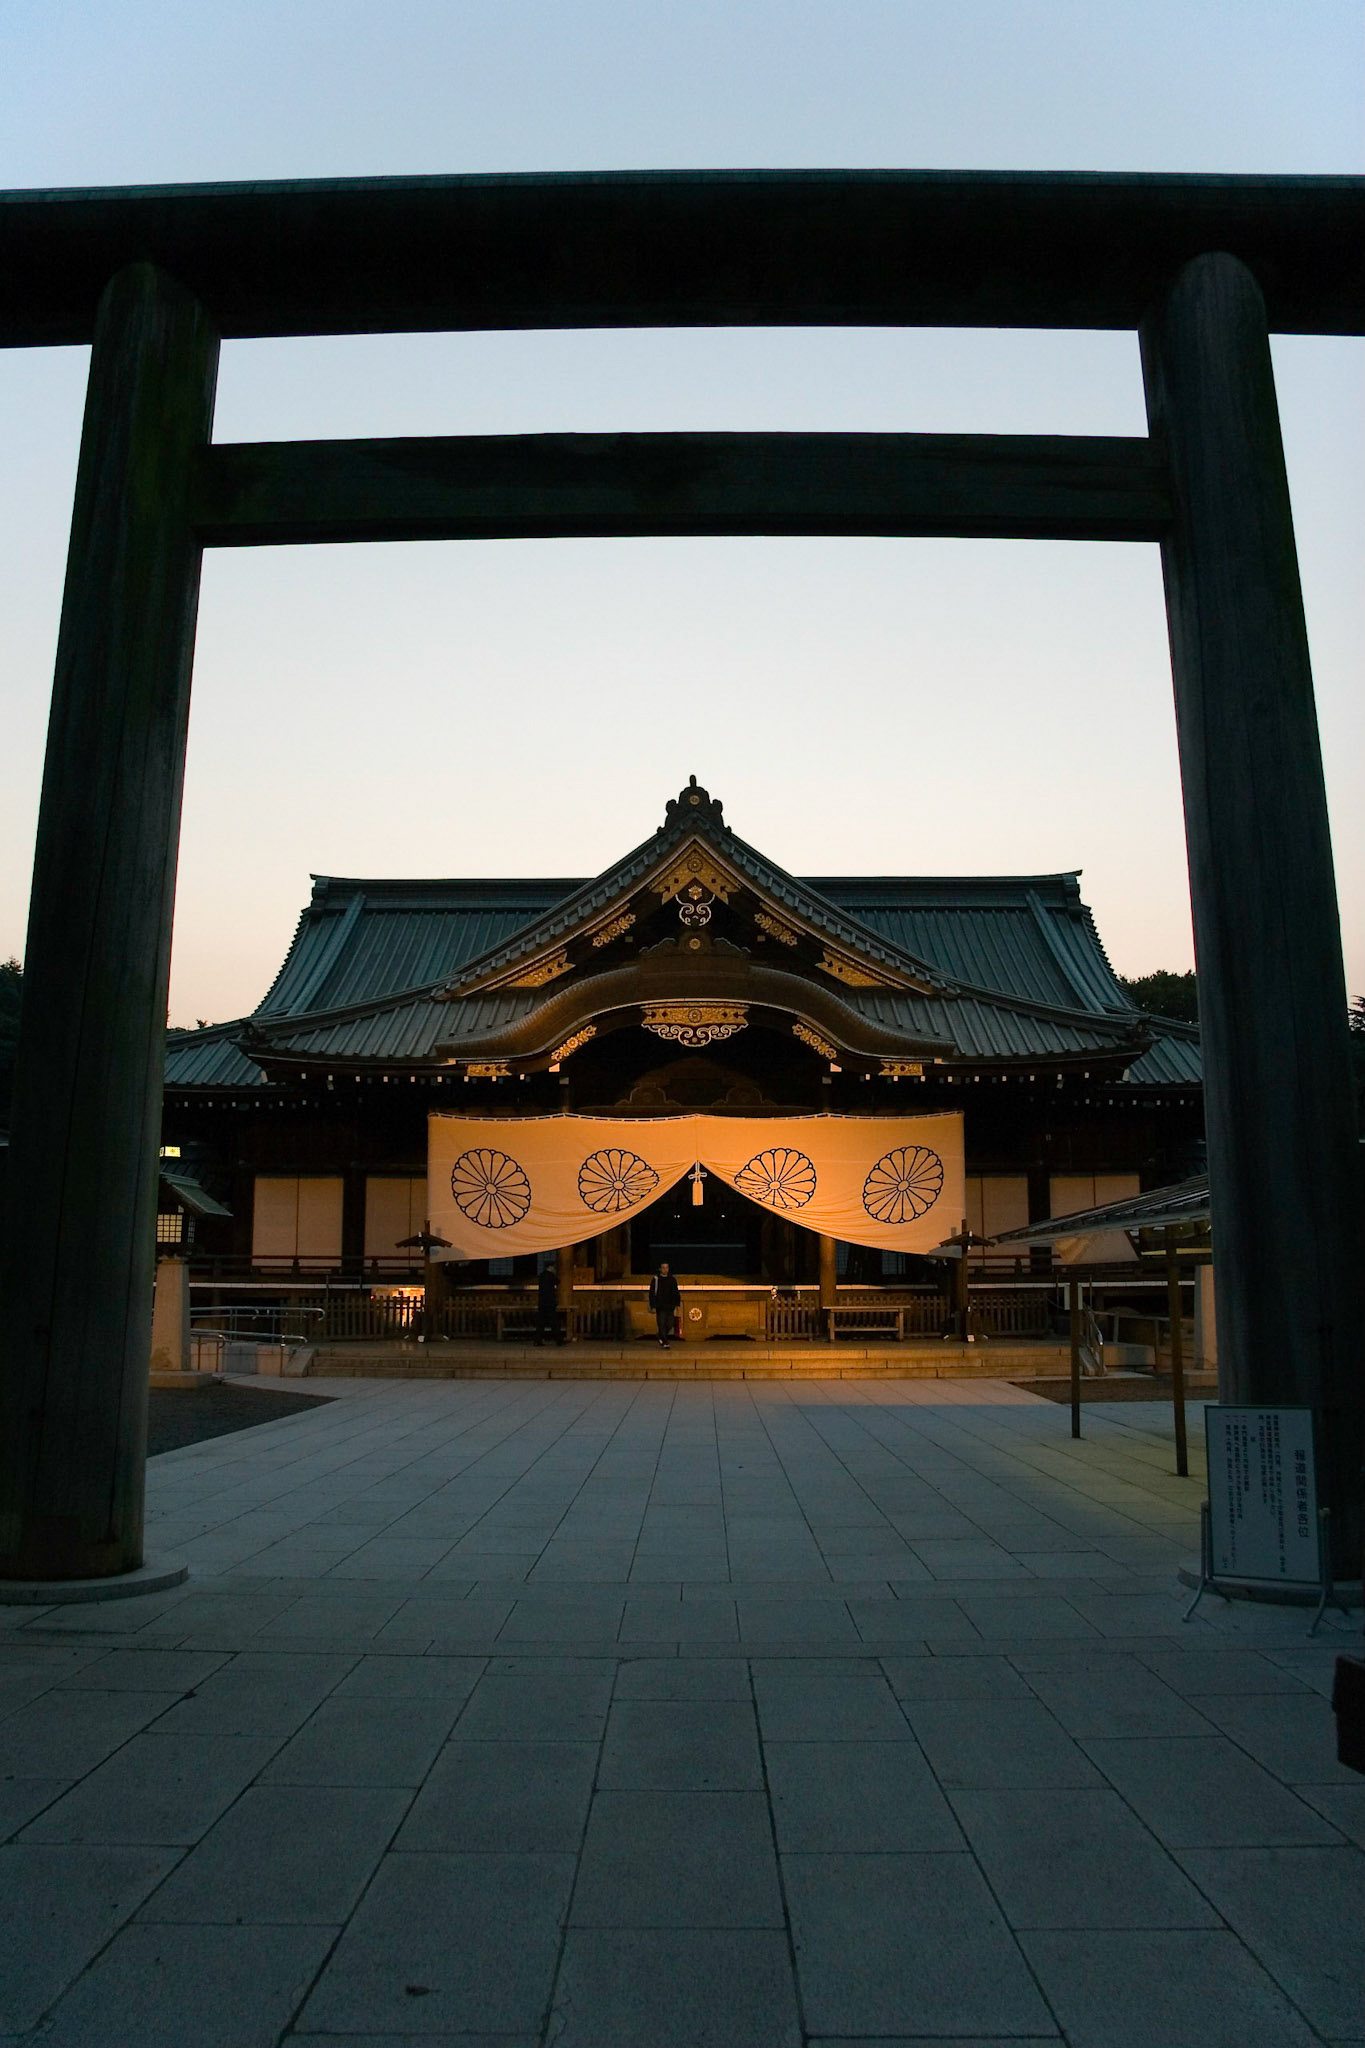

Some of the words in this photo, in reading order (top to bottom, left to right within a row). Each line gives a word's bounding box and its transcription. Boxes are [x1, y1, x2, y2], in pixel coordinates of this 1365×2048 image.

[1294, 1449, 1310, 1538] 報道関係者各位
